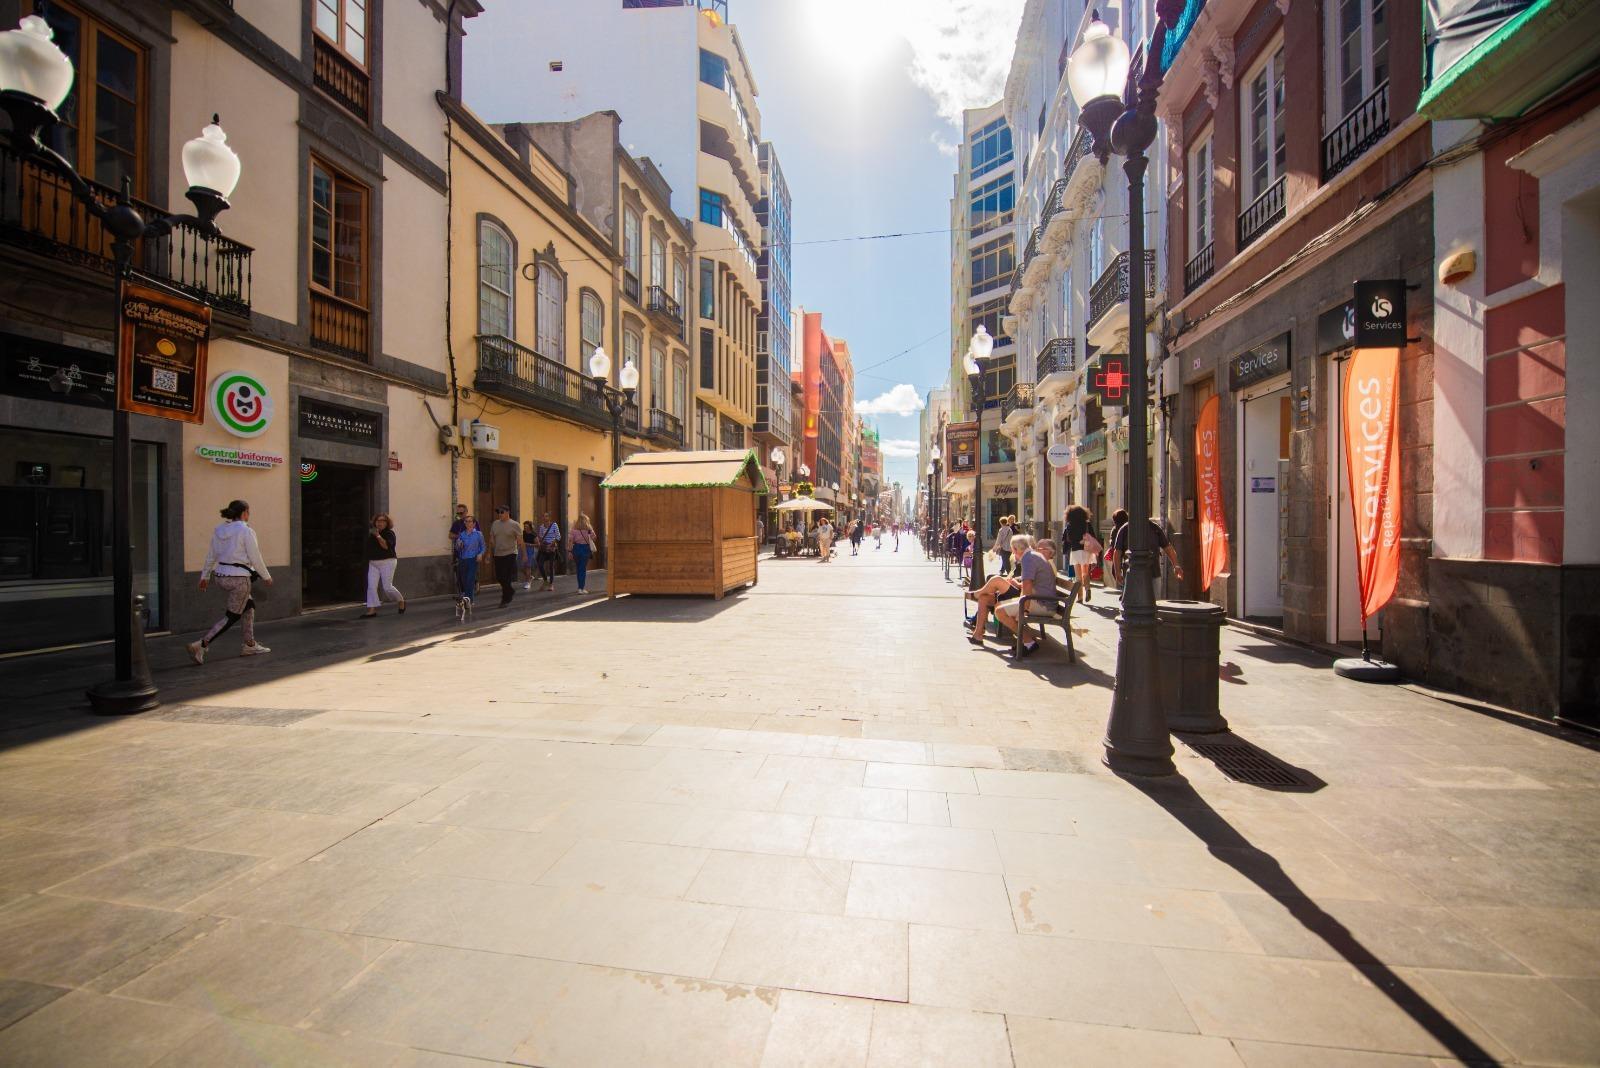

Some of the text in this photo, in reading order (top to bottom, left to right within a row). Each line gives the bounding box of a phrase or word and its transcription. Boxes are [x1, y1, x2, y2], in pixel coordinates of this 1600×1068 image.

[143, 312, 205, 338] METROPOLE
[307, 413, 372, 430] UNIFORMES PARA
[215, 457, 272, 468] SIEMPRE RESPONDE
